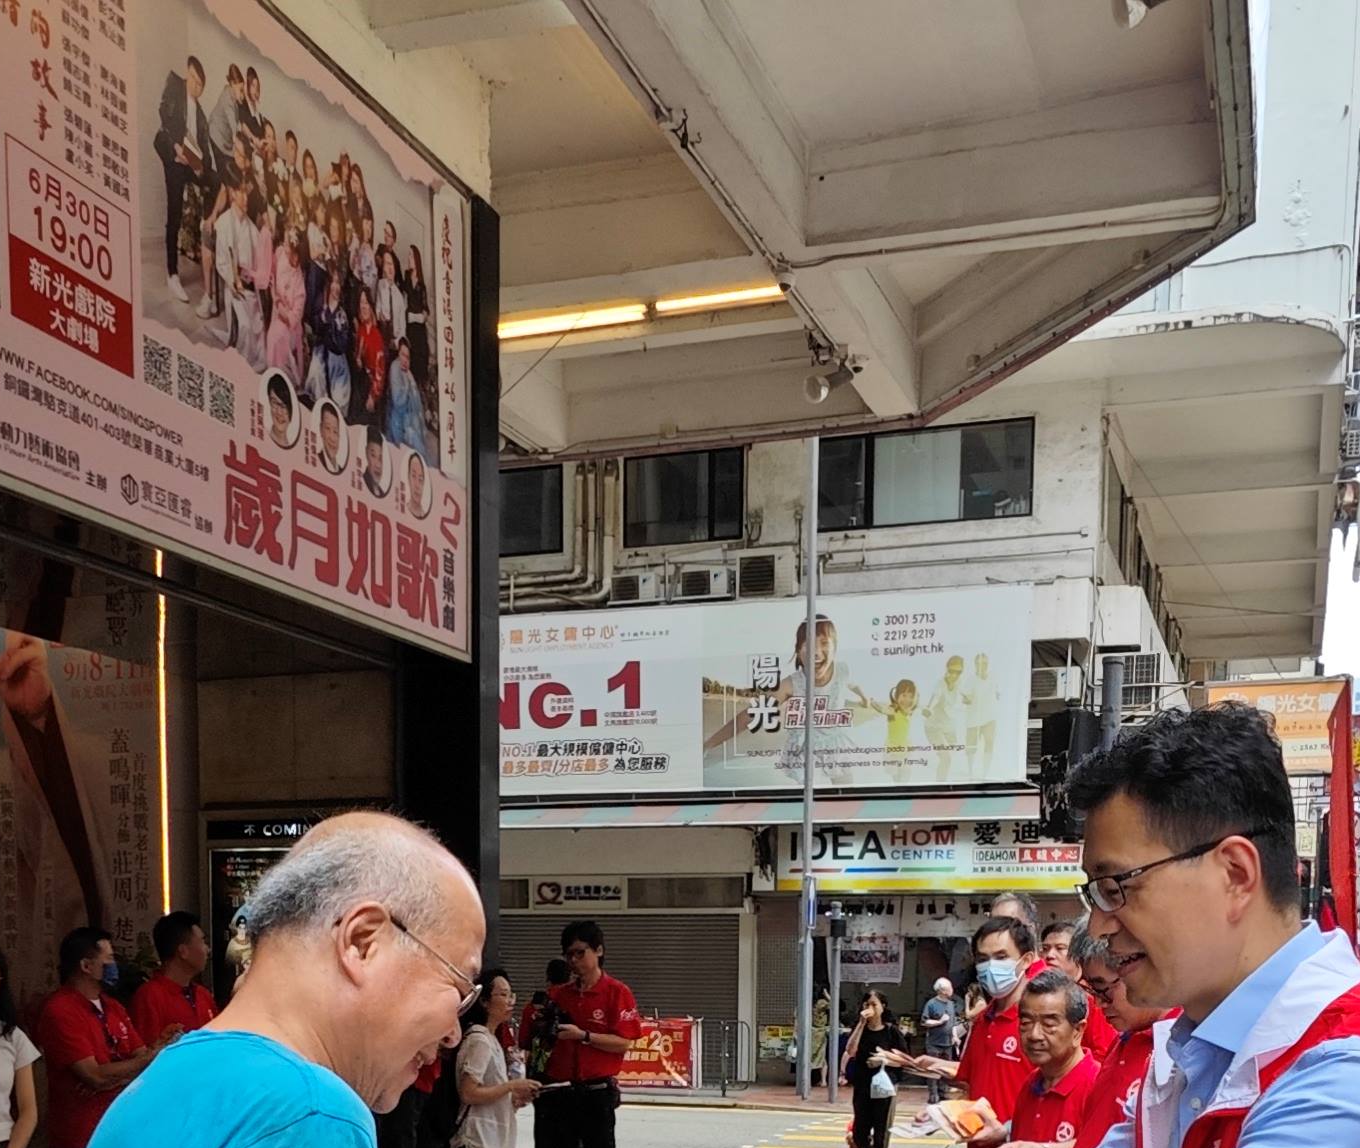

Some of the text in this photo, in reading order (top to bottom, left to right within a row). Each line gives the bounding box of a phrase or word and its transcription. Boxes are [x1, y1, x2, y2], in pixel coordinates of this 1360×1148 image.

[28, 168, 112, 241] 6月30日
[34, 205, 114, 281] 19:00
[29, 257, 117, 334] 新光戲院
[50, 308, 100, 354] 大劇場
[223, 439, 439, 628] 歲月如歌
[884, 613, 936, 627] 3001 5713
[884, 629, 935, 641] 2219 2219
[883, 643, 944, 657] sunlight.hk
[748, 655, 781, 734] 陽光
[112, 850, 132, 903] 莊周
[891, 849, 956, 860] CENTRE
[975, 849, 1017, 861] IDEAHOM
